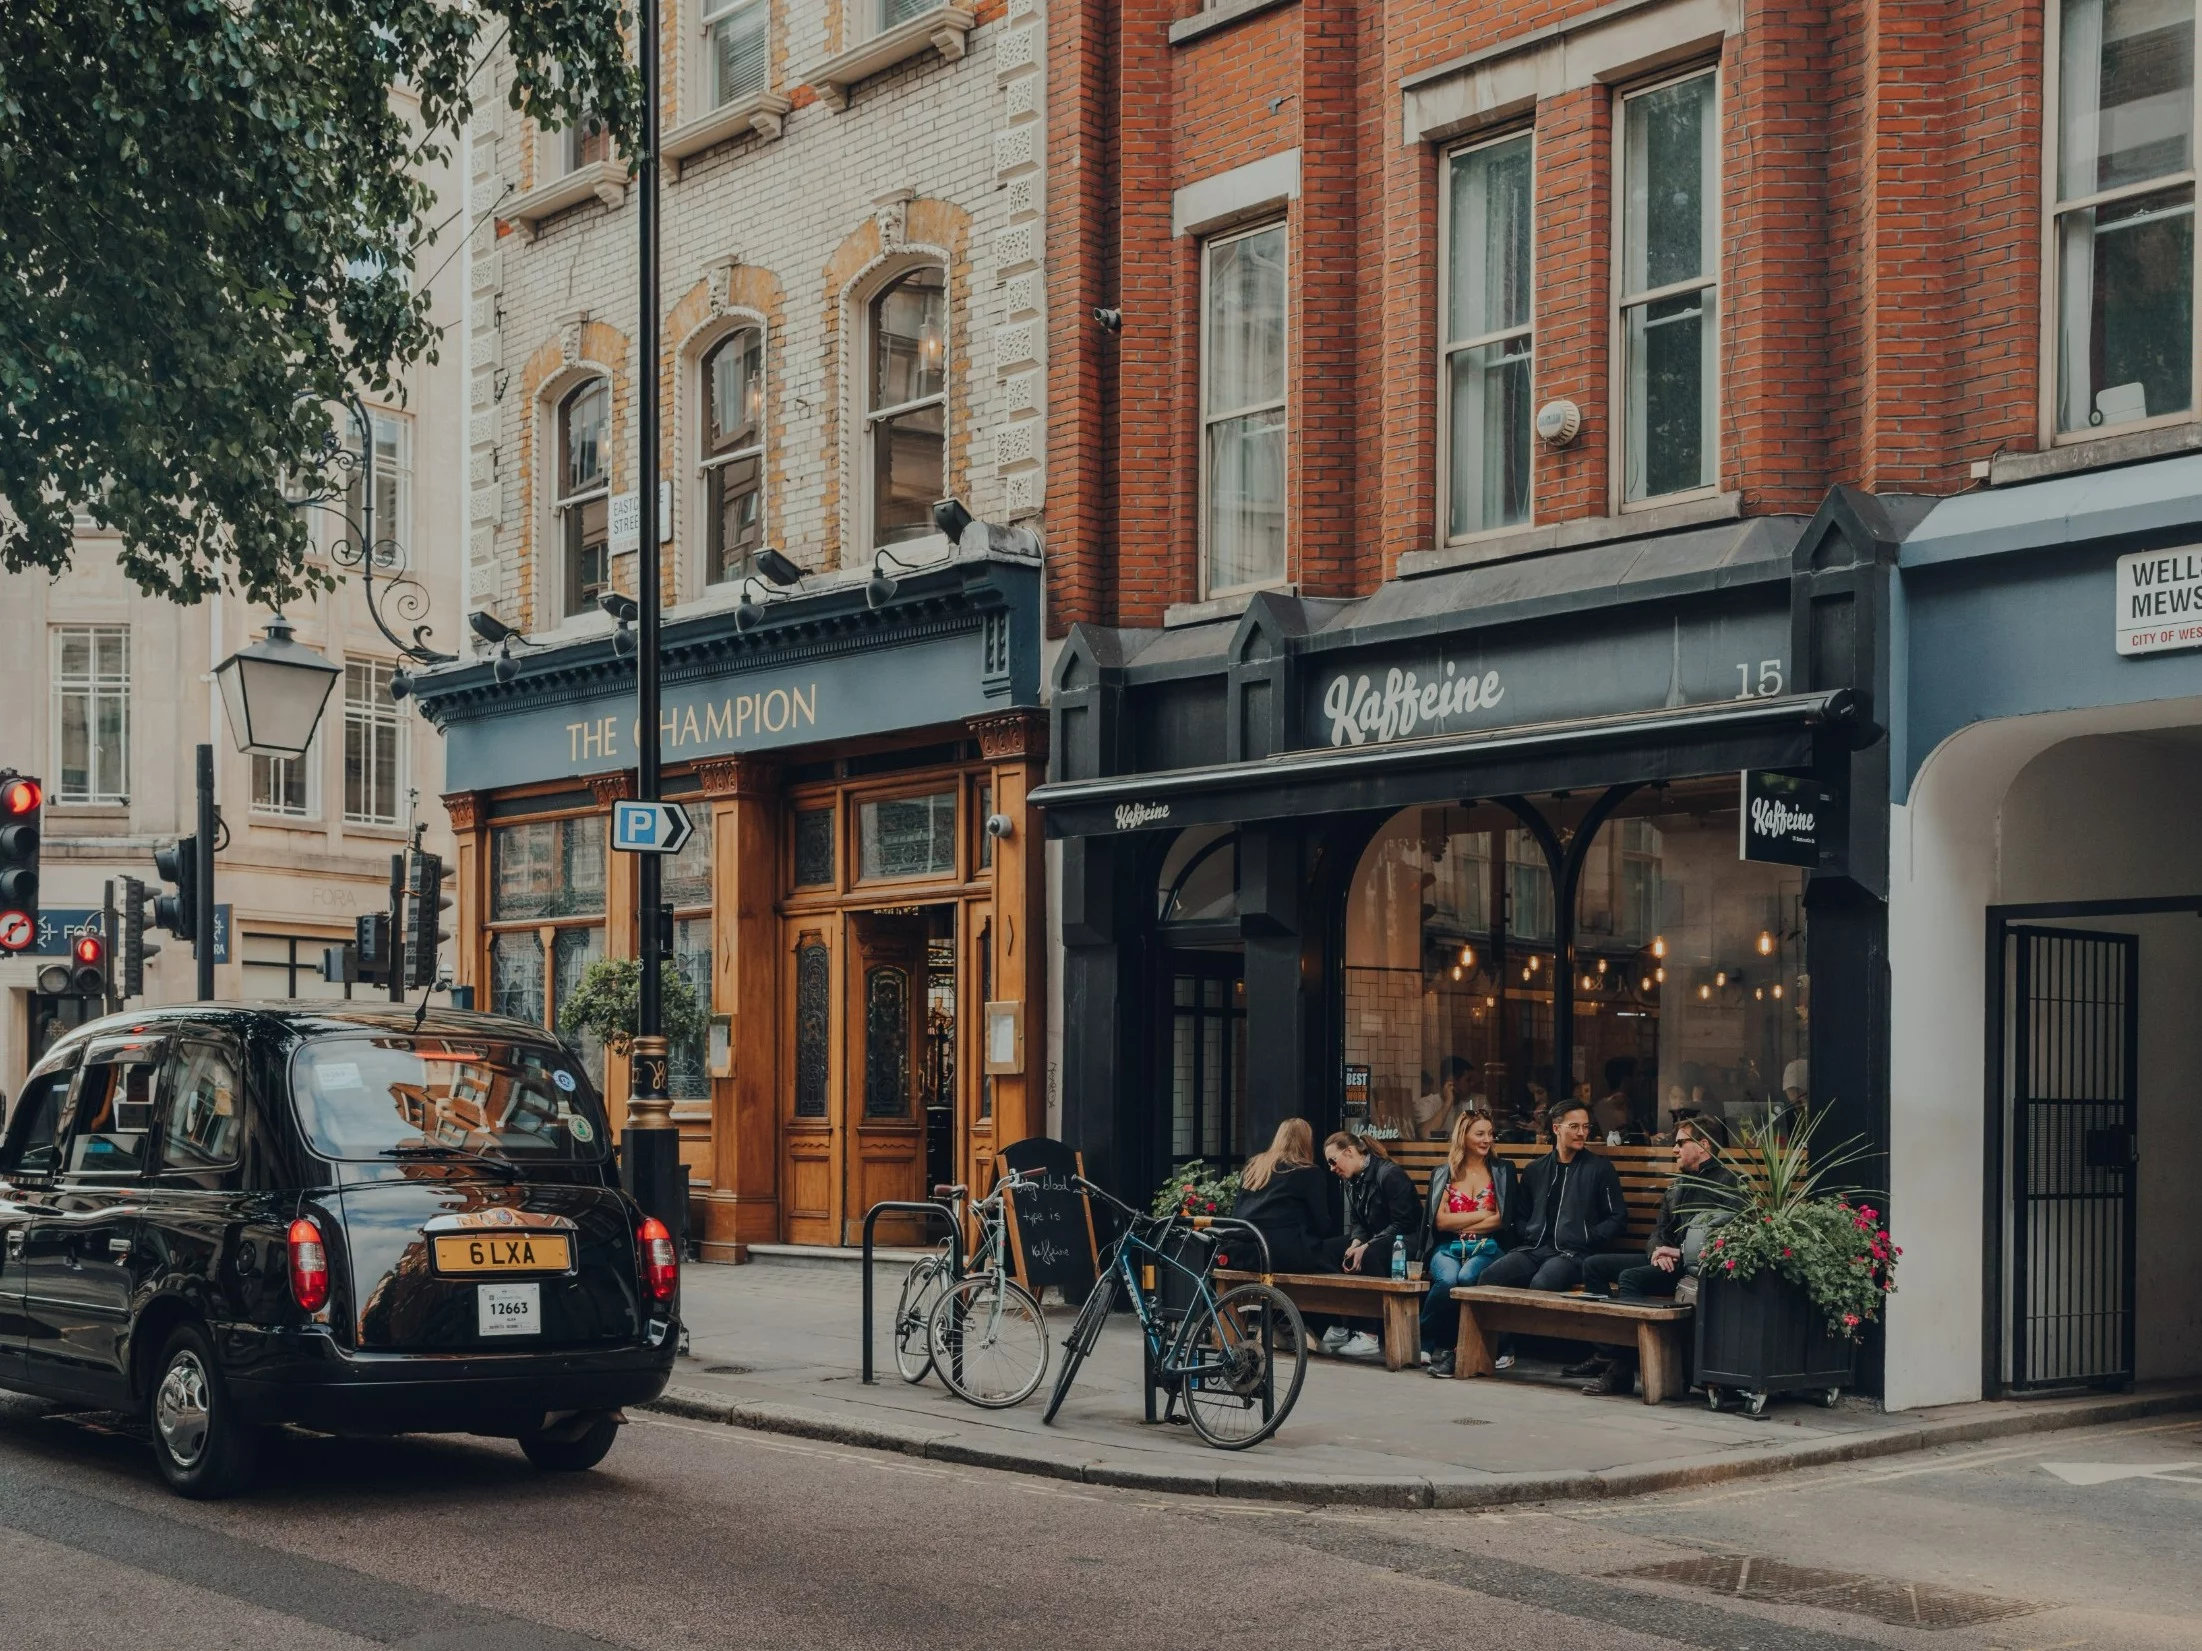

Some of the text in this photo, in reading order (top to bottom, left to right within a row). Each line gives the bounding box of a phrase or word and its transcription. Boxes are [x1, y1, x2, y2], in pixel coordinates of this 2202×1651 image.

[2132, 555, 2202, 587] WELL
[2132, 585, 2202, 618] MEWS
[2132, 633, 2156, 647] CITY
[2160, 630, 2175, 643] OF
[1735, 659, 1783, 700] 15
[1324, 661, 1505, 747] Kaffeine
[566, 717, 617, 762] THE
[627, 810, 653, 842] P
[1115, 801, 1170, 830] Kaffeine
[1752, 797, 1816, 838] Kaffeine
[312, 887, 357, 907] FORA
[1346, 1073, 1368, 1086] BEST
[1043, 1174, 1071, 1191] blood
[1023, 1208, 1061, 1227] type is
[490, 1241, 536, 1265] LXA
[490, 1302, 528, 1315] 12663
